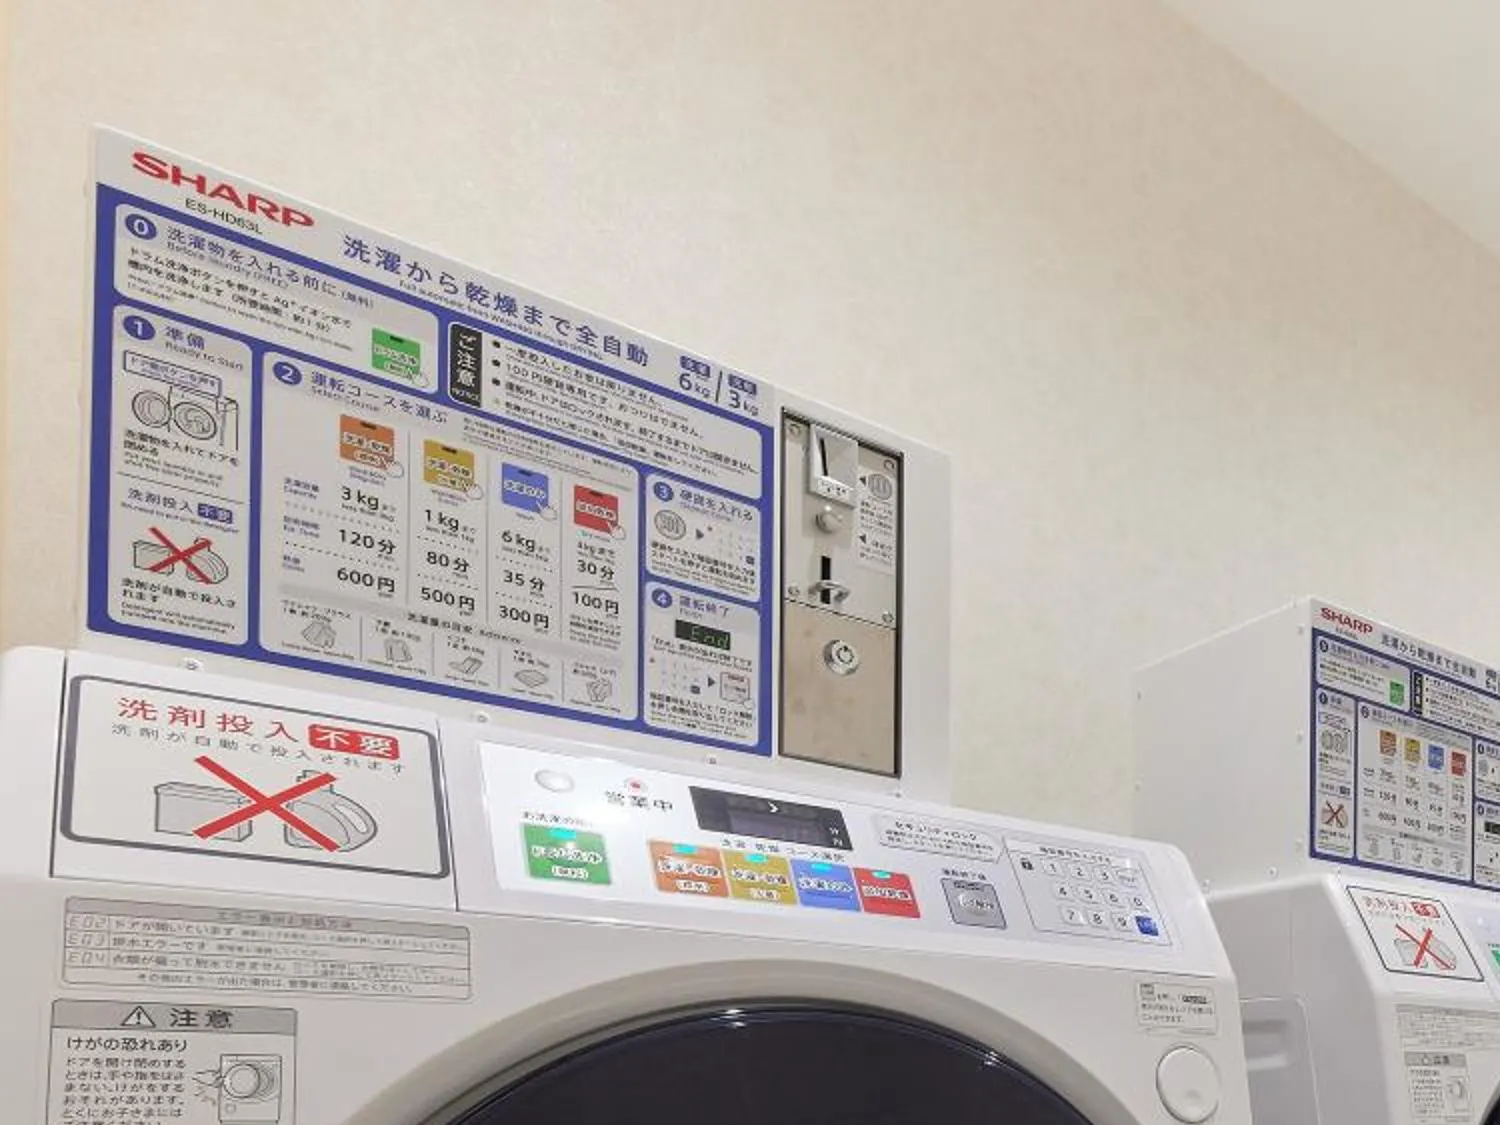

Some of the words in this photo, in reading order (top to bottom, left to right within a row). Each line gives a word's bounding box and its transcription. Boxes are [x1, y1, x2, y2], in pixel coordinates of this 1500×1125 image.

[132, 151, 315, 227] SHARP
[167, 224, 336, 297] 洗濯物を入れる前に
[342, 234, 649, 368] 洗濯から乾燥まで全自動
[456, 330, 478, 389] ご注意
[311, 370, 447, 425] 運転コースを選ぶ
[338, 527, 396, 556] 120分
[426, 549, 469, 574] 80分
[576, 558, 613, 581] 30分
[336, 565, 395, 593] 600円
[502, 568, 544, 592] 35分
[421, 585, 474, 612] 500円
[572, 590, 618, 615] 100円
[499, 603, 549, 629] 300円
[1320, 606, 1373, 634] SHARP
[116, 697, 299, 744] 洗剤投入
[316, 728, 398, 759] 不要
[111, 723, 406, 776] 洗剤が自動で投入されます
[169, 1008, 233, 1030] 注意
[66, 1036, 188, 1053] けがの恐れあり
